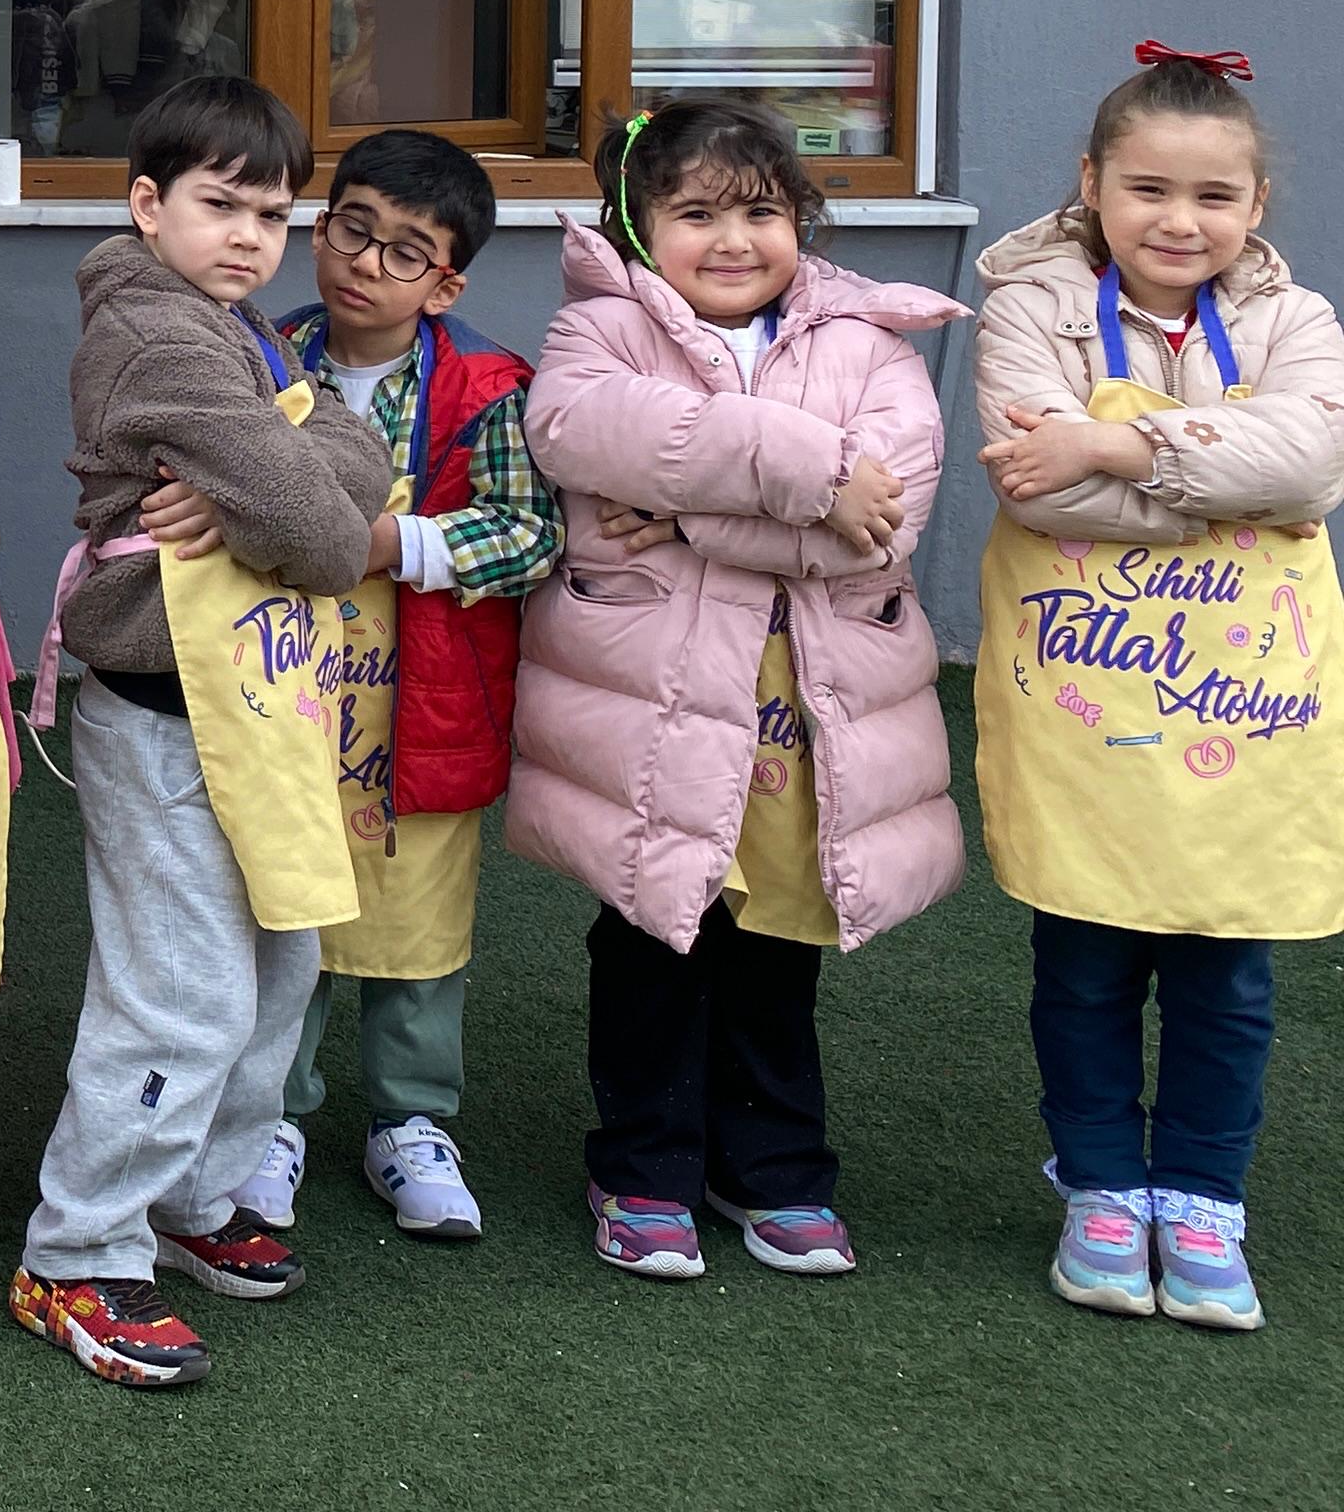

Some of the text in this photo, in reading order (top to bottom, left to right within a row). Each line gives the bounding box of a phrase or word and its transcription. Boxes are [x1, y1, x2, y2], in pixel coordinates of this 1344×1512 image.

[1098, 548, 1244, 604] Sihirli
[1021, 588, 1196, 679] Tatlar
[1154, 668, 1321, 739] Atölyesi
